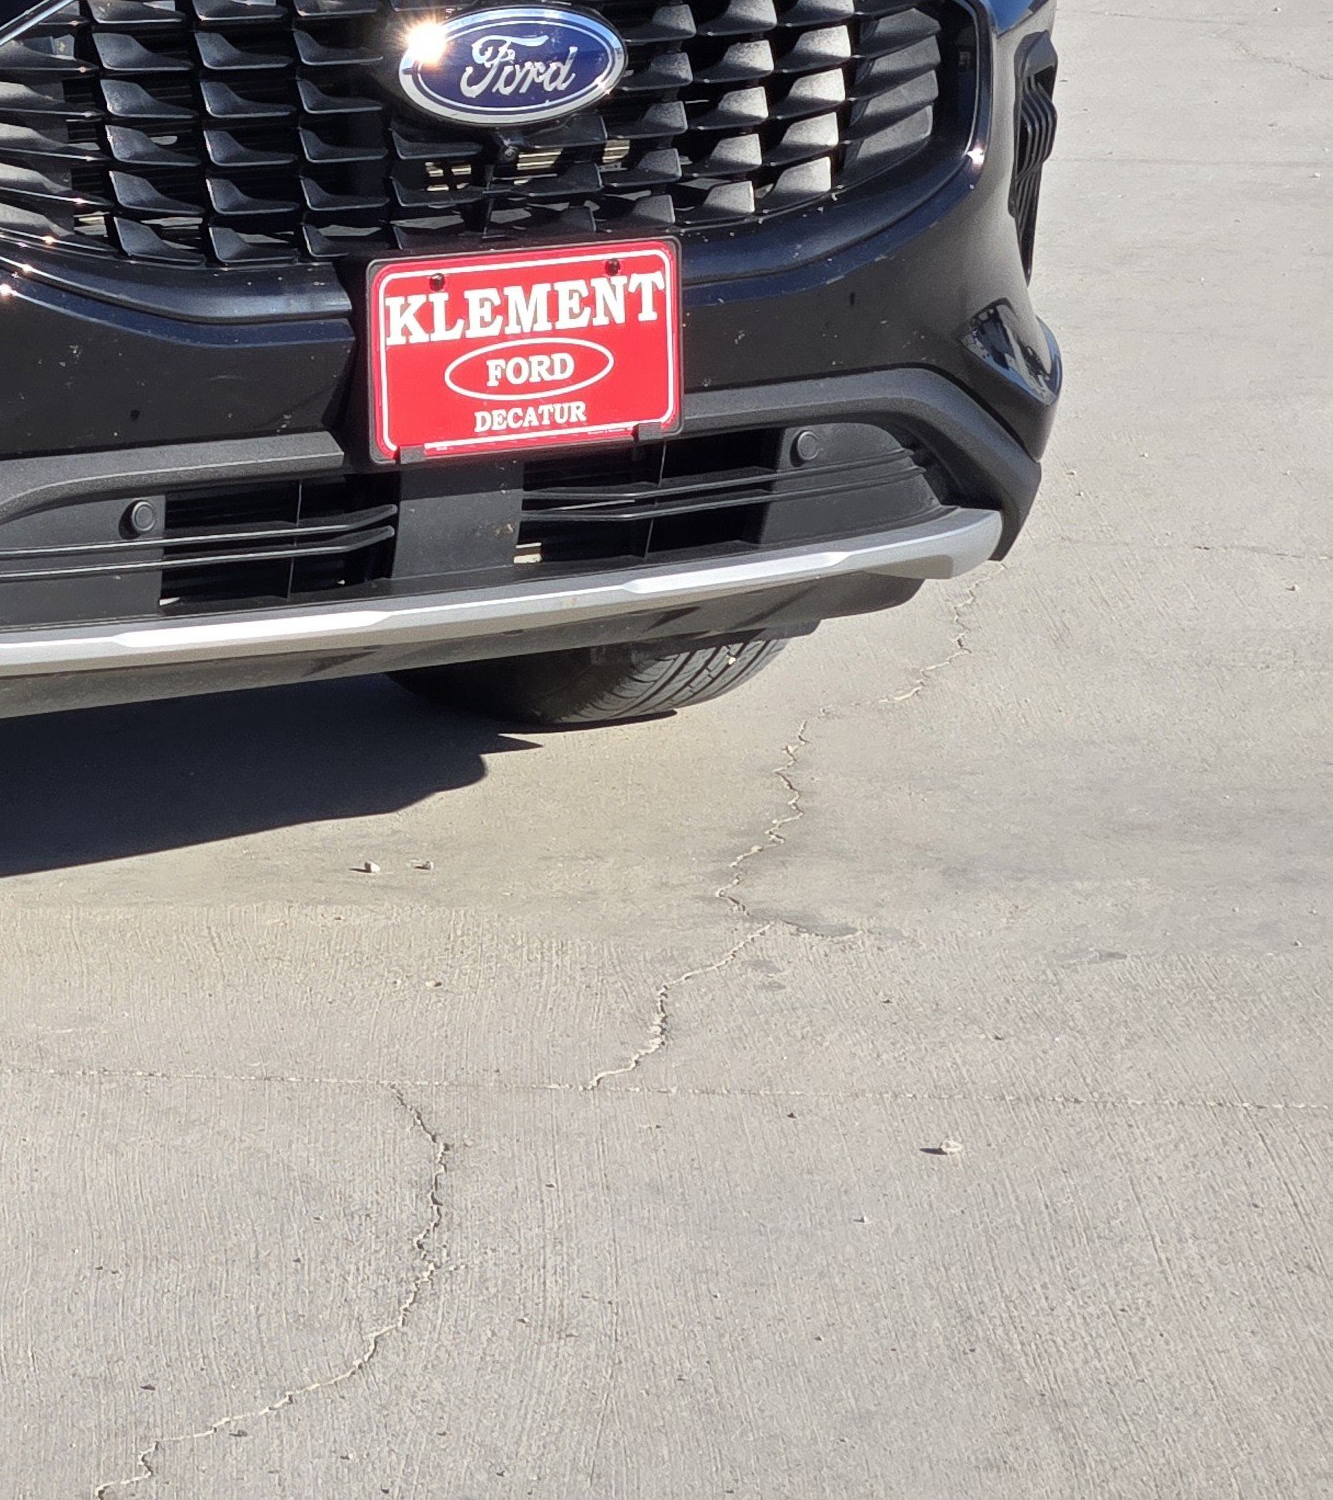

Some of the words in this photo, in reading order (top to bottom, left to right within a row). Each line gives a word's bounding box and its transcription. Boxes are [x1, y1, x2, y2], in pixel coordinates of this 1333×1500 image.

[460, 34, 579, 99] Ford
[385, 271, 665, 347] KLEMENT
[485, 352, 575, 387] FORD
[474, 401, 587, 433] DECATUR
